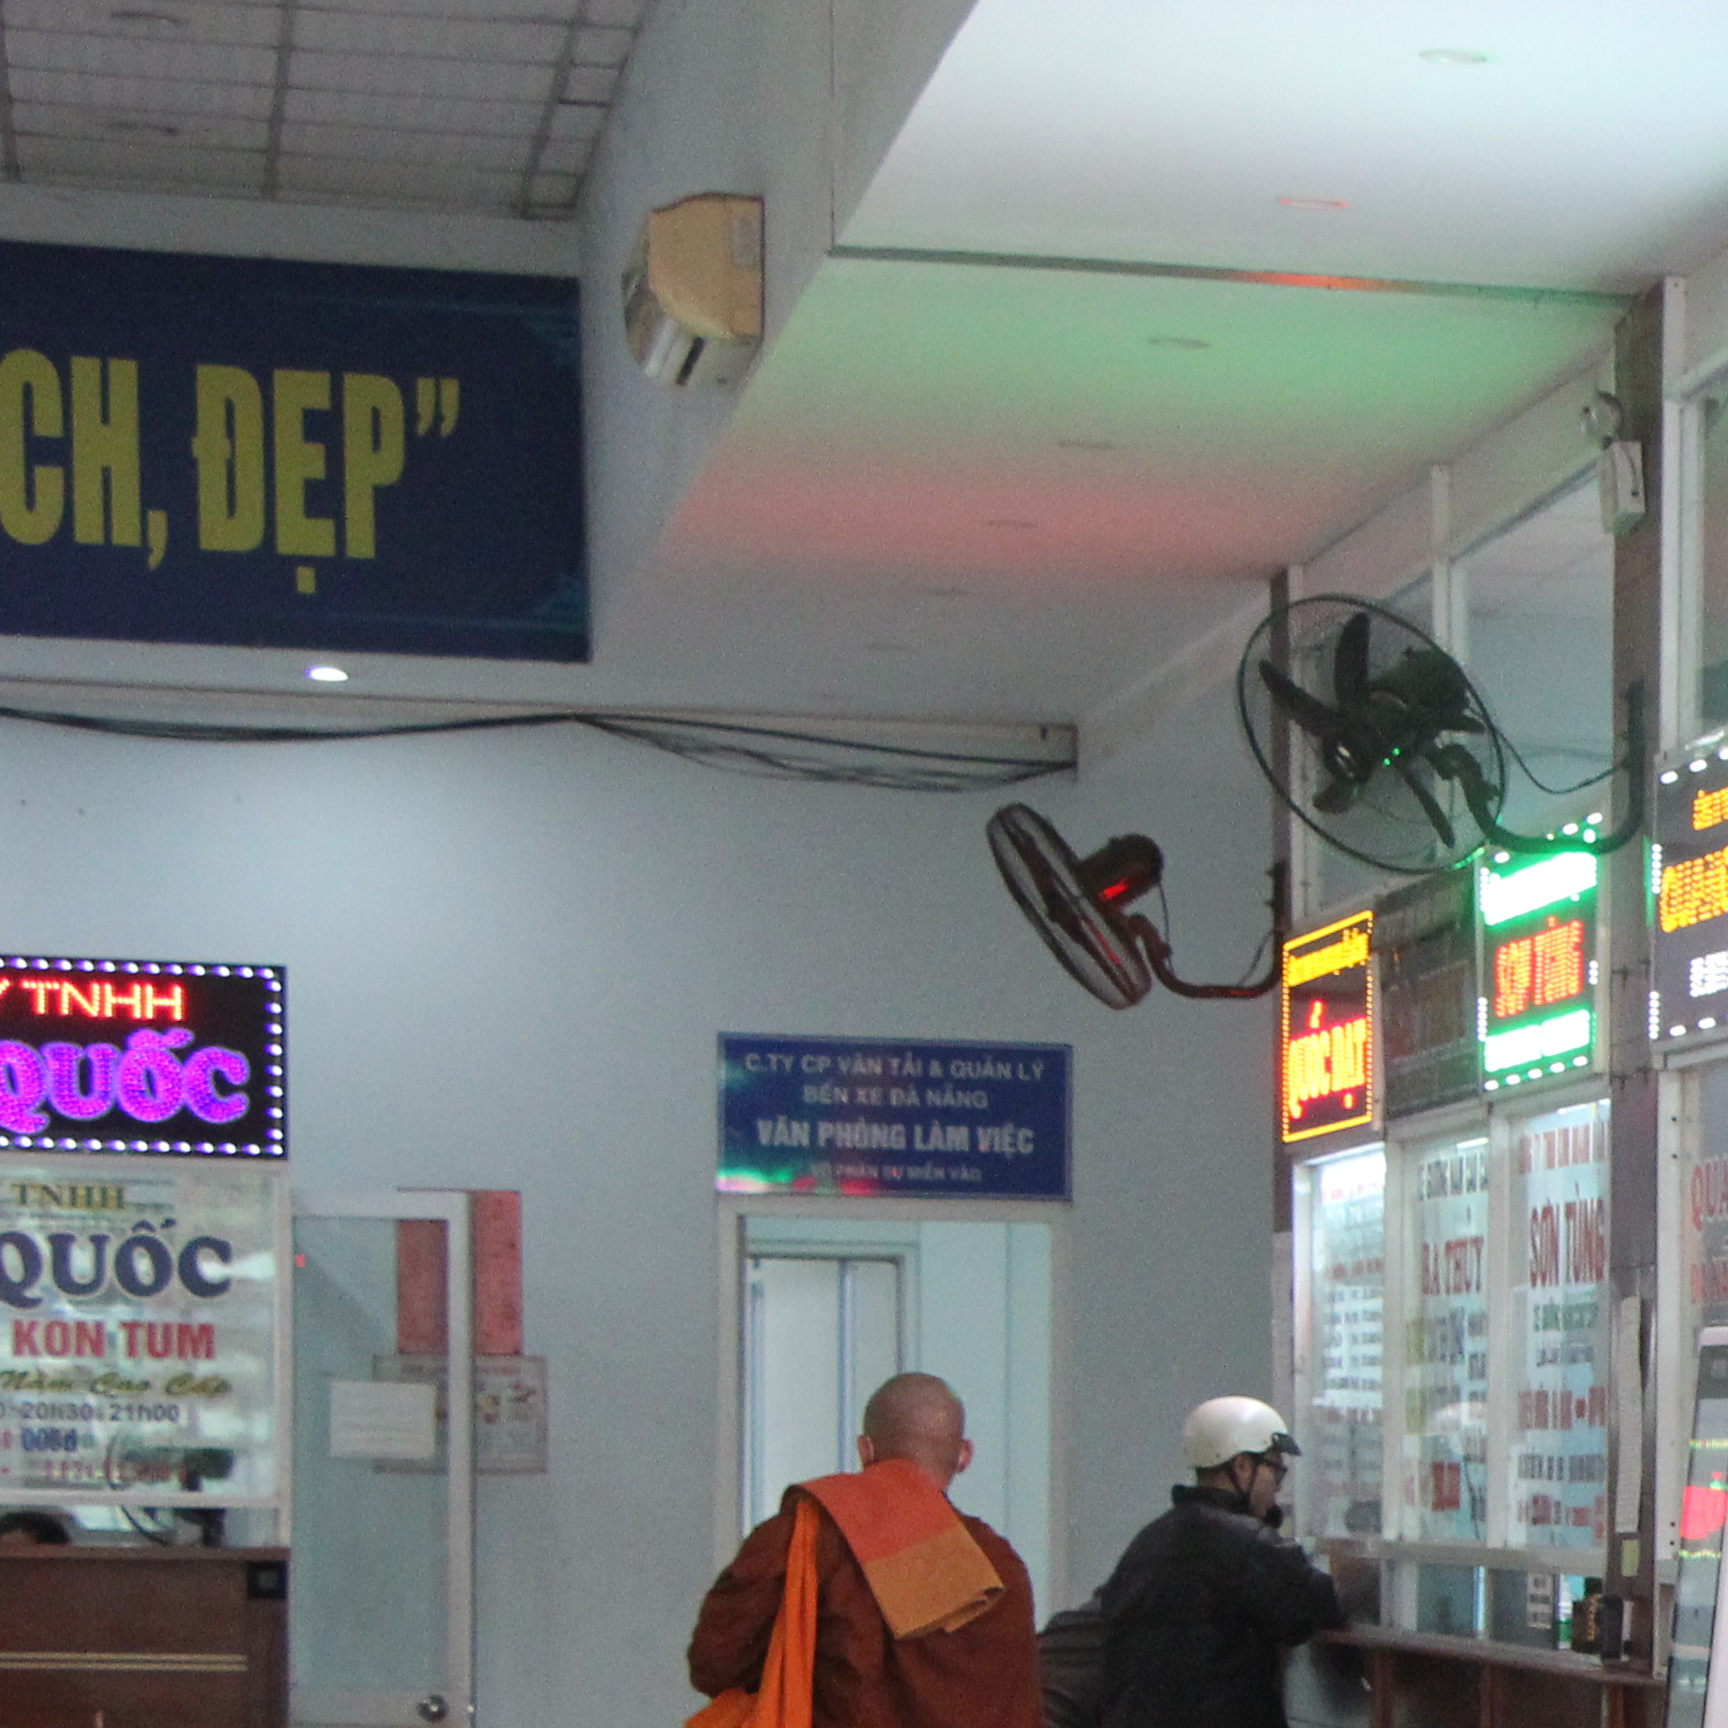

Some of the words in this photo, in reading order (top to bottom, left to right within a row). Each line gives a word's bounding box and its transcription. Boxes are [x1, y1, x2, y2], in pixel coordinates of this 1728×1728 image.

[23, 981, 188, 1021] TNHH
[0, 1028, 250, 1134] QUỐC
[1018, 1056, 1045, 1081] LÝ
[758, 1115, 811, 1148] VĂN
[818, 1118, 906, 1151] PHÒNG
[915, 1120, 969, 1152] LÀM
[978, 1124, 1036, 1160] VIỆC
[12, 1184, 124, 1210] TNHH
[0, 1217, 233, 1308] QUỐC
[12, 1320, 104, 1357] KON
[118, 1321, 214, 1359] TUM
